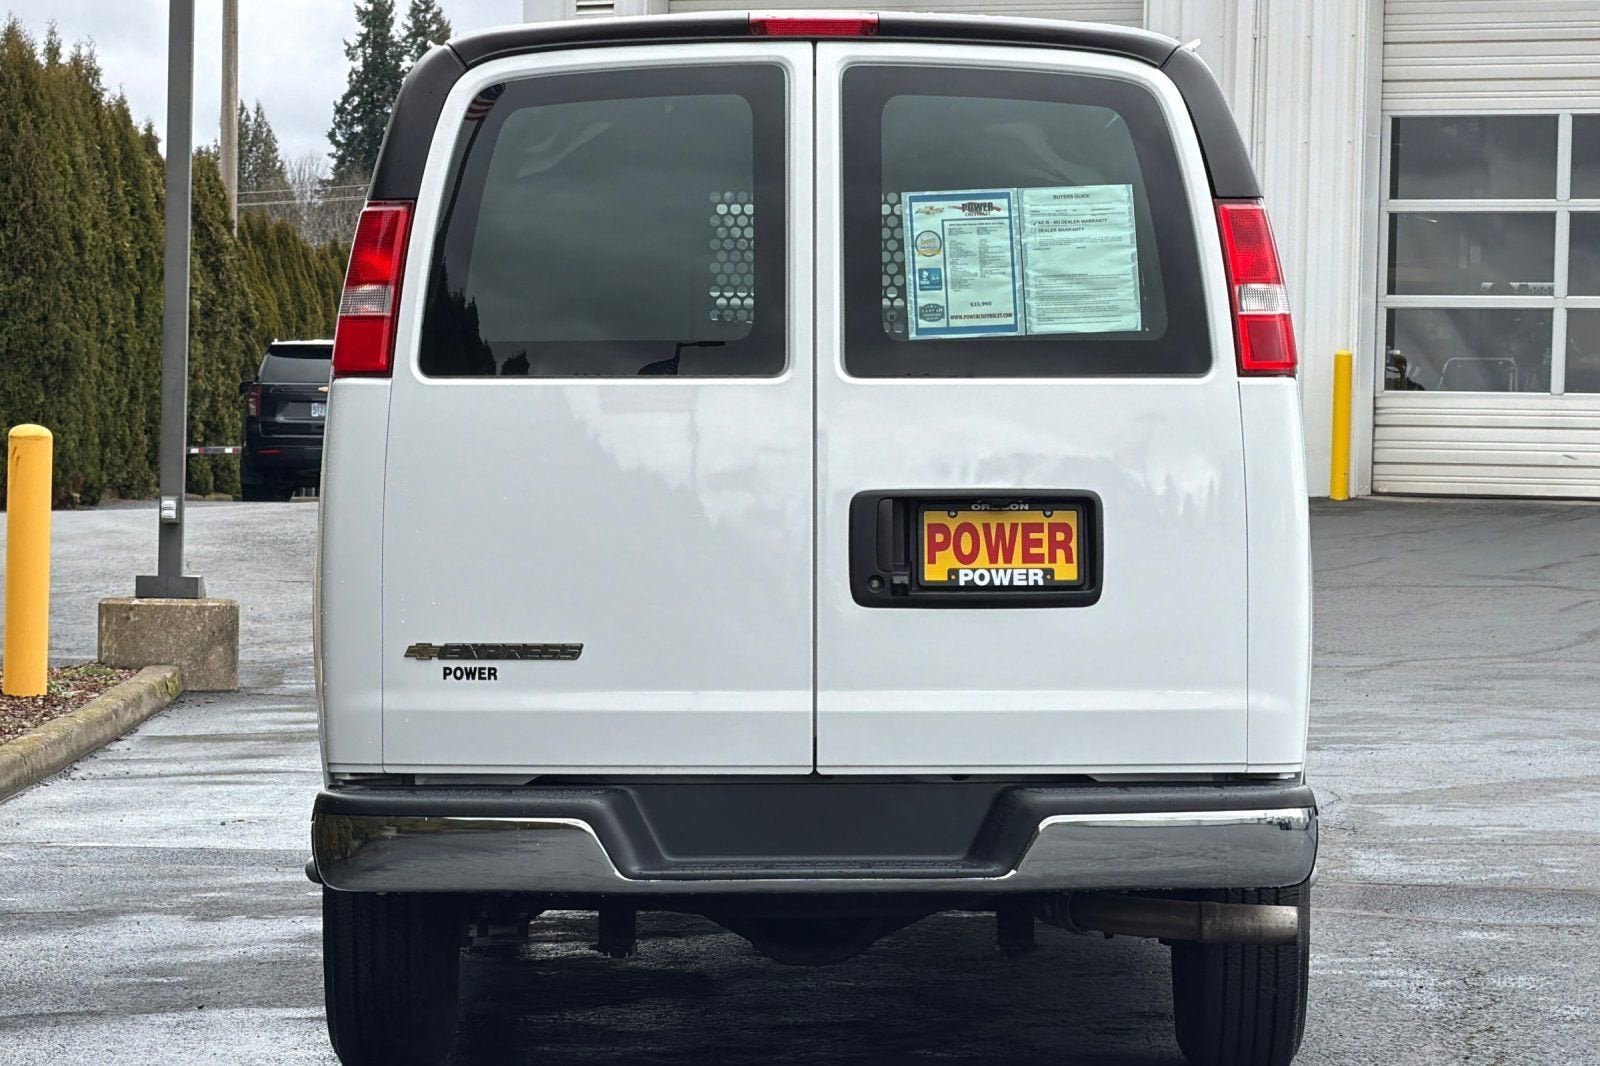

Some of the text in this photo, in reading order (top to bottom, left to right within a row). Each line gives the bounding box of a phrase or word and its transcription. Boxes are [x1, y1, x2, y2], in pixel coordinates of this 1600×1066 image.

[962, 202, 993, 213] POWER
[971, 503, 1029, 511] ORON
[927, 522, 1074, 565] POWER
[958, 568, 1044, 586] POWER
[438, 643, 584, 660] EXPRESS
[442, 666, 498, 680] POWER
